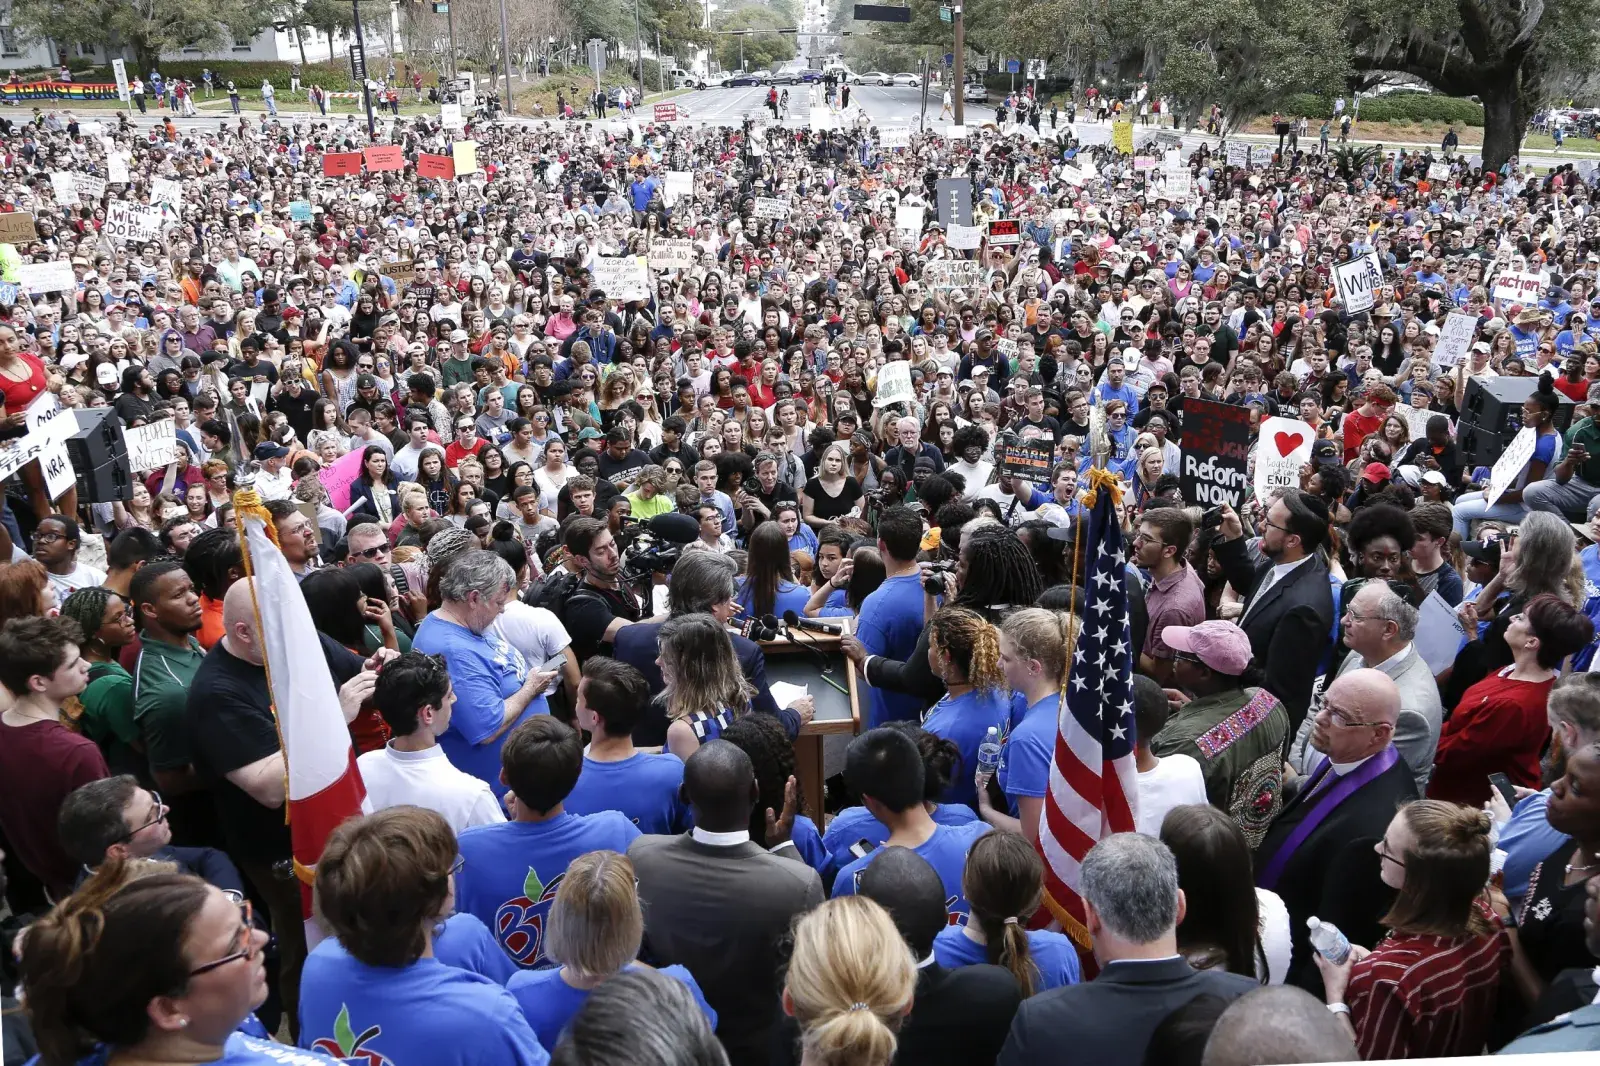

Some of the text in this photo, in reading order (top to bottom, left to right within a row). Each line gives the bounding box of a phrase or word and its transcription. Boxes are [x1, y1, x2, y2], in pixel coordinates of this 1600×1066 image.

[14, 84, 73, 100] AGAINST
[107, 221, 125, 236] DO
[990, 227, 1018, 236] SALE
[994, 221, 1014, 229] FOR
[602, 258, 636, 266] FLORIDA
[946, 261, 978, 274] PEACE
[1499, 274, 1540, 293] action
[1448, 316, 1464, 326] OUR
[1451, 326, 1470, 338] KIDS
[1398, 405, 1418, 421] WE
[139, 419, 174, 442] PEOPLE
[1005, 445, 1051, 462] DISARM
[46, 454, 67, 481] NRA
[1011, 457, 1035, 466] HATE
[1185, 455, 1247, 489] Reform
[1267, 474, 1291, 486] END
[1195, 482, 1240, 508] NOW
